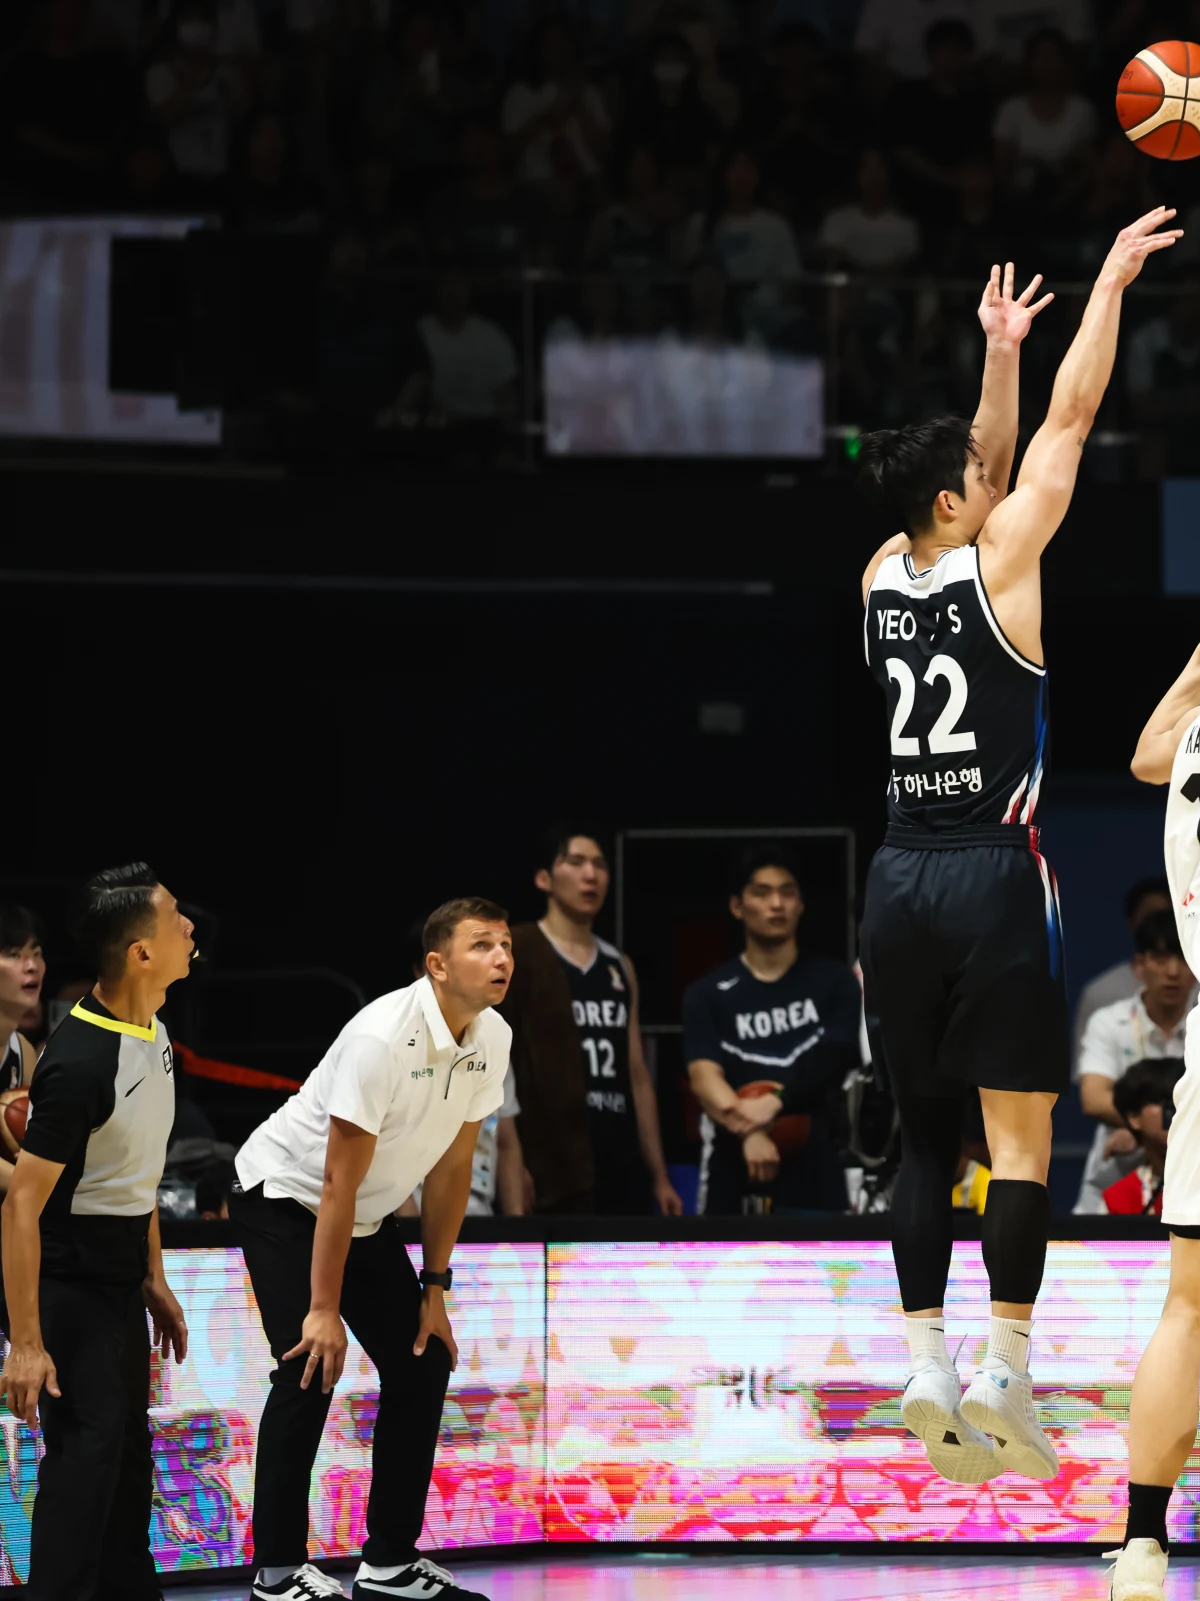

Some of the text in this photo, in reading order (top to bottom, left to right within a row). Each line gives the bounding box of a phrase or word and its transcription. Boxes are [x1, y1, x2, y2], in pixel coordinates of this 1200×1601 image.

[876, 609, 917, 641] YEO
[947, 603, 962, 634] S
[885, 653, 977, 757] 22
[903, 767, 983, 798] 하나은행
[571, 999, 628, 1028] OREA
[735, 997, 821, 1041] KOREA
[581, 1036, 617, 1079] 12
